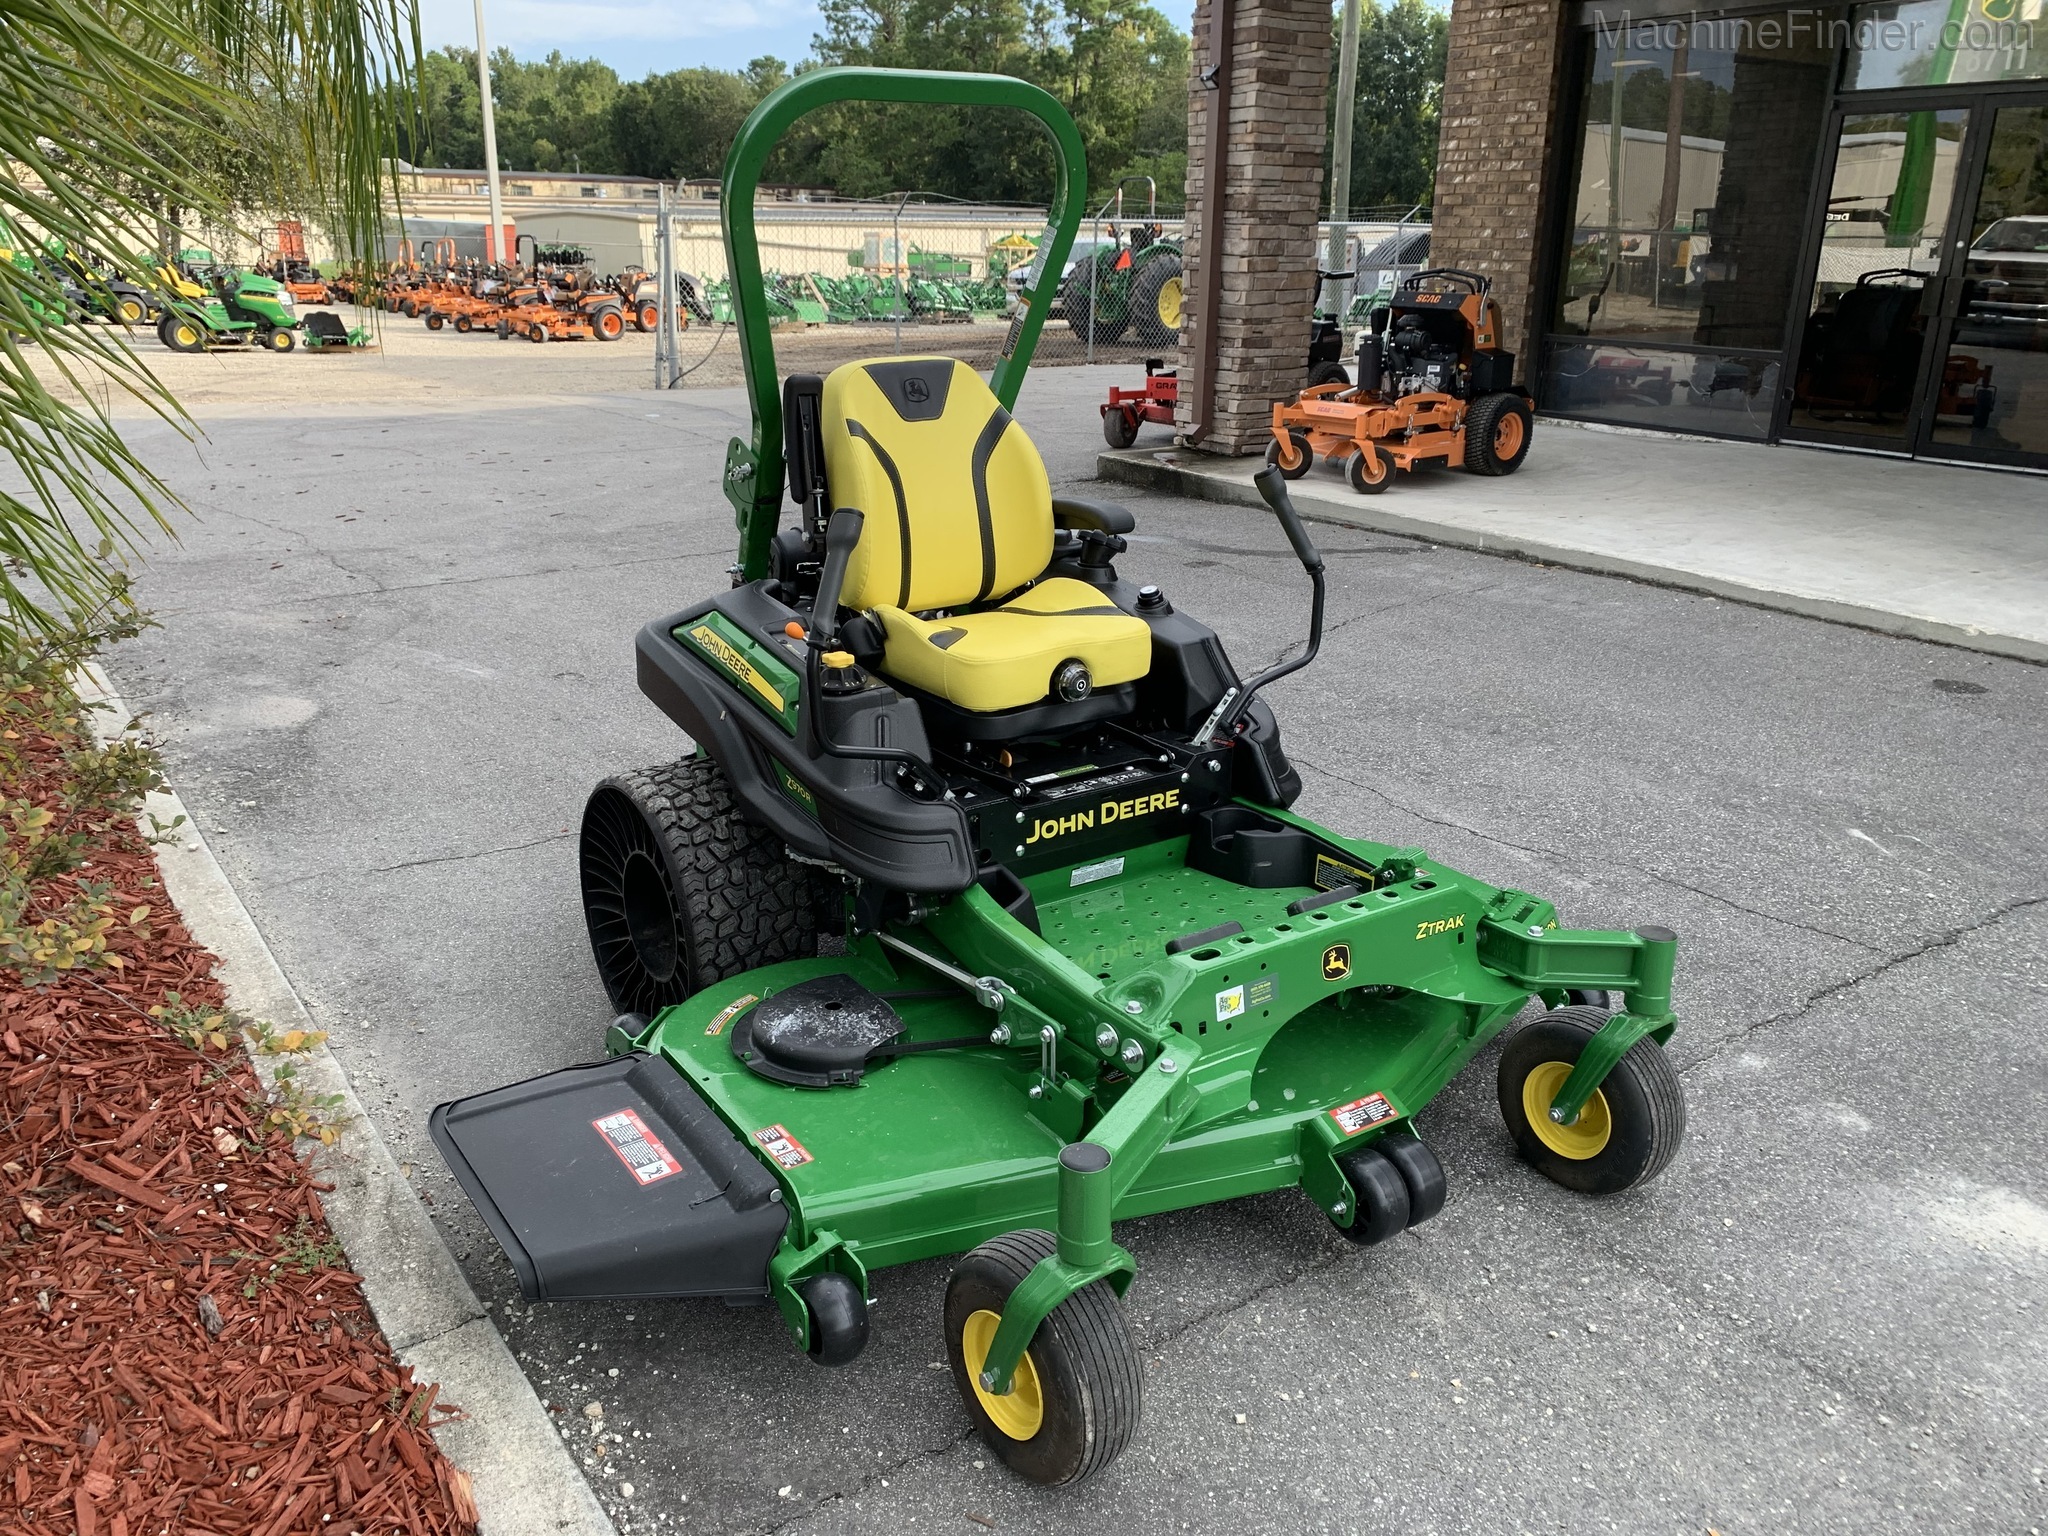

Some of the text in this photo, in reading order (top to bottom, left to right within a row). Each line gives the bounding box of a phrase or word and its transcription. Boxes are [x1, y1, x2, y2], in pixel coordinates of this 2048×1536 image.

[1416, 294, 1441, 304] SCAG
[1155, 382, 1177, 390] GRA
[697, 629, 752, 682] JOHN DEERE
[785, 774, 812, 804] Z970R
[1026, 789, 1180, 844] JOHN DEERE
[1415, 913, 1466, 941] ZTRAK
